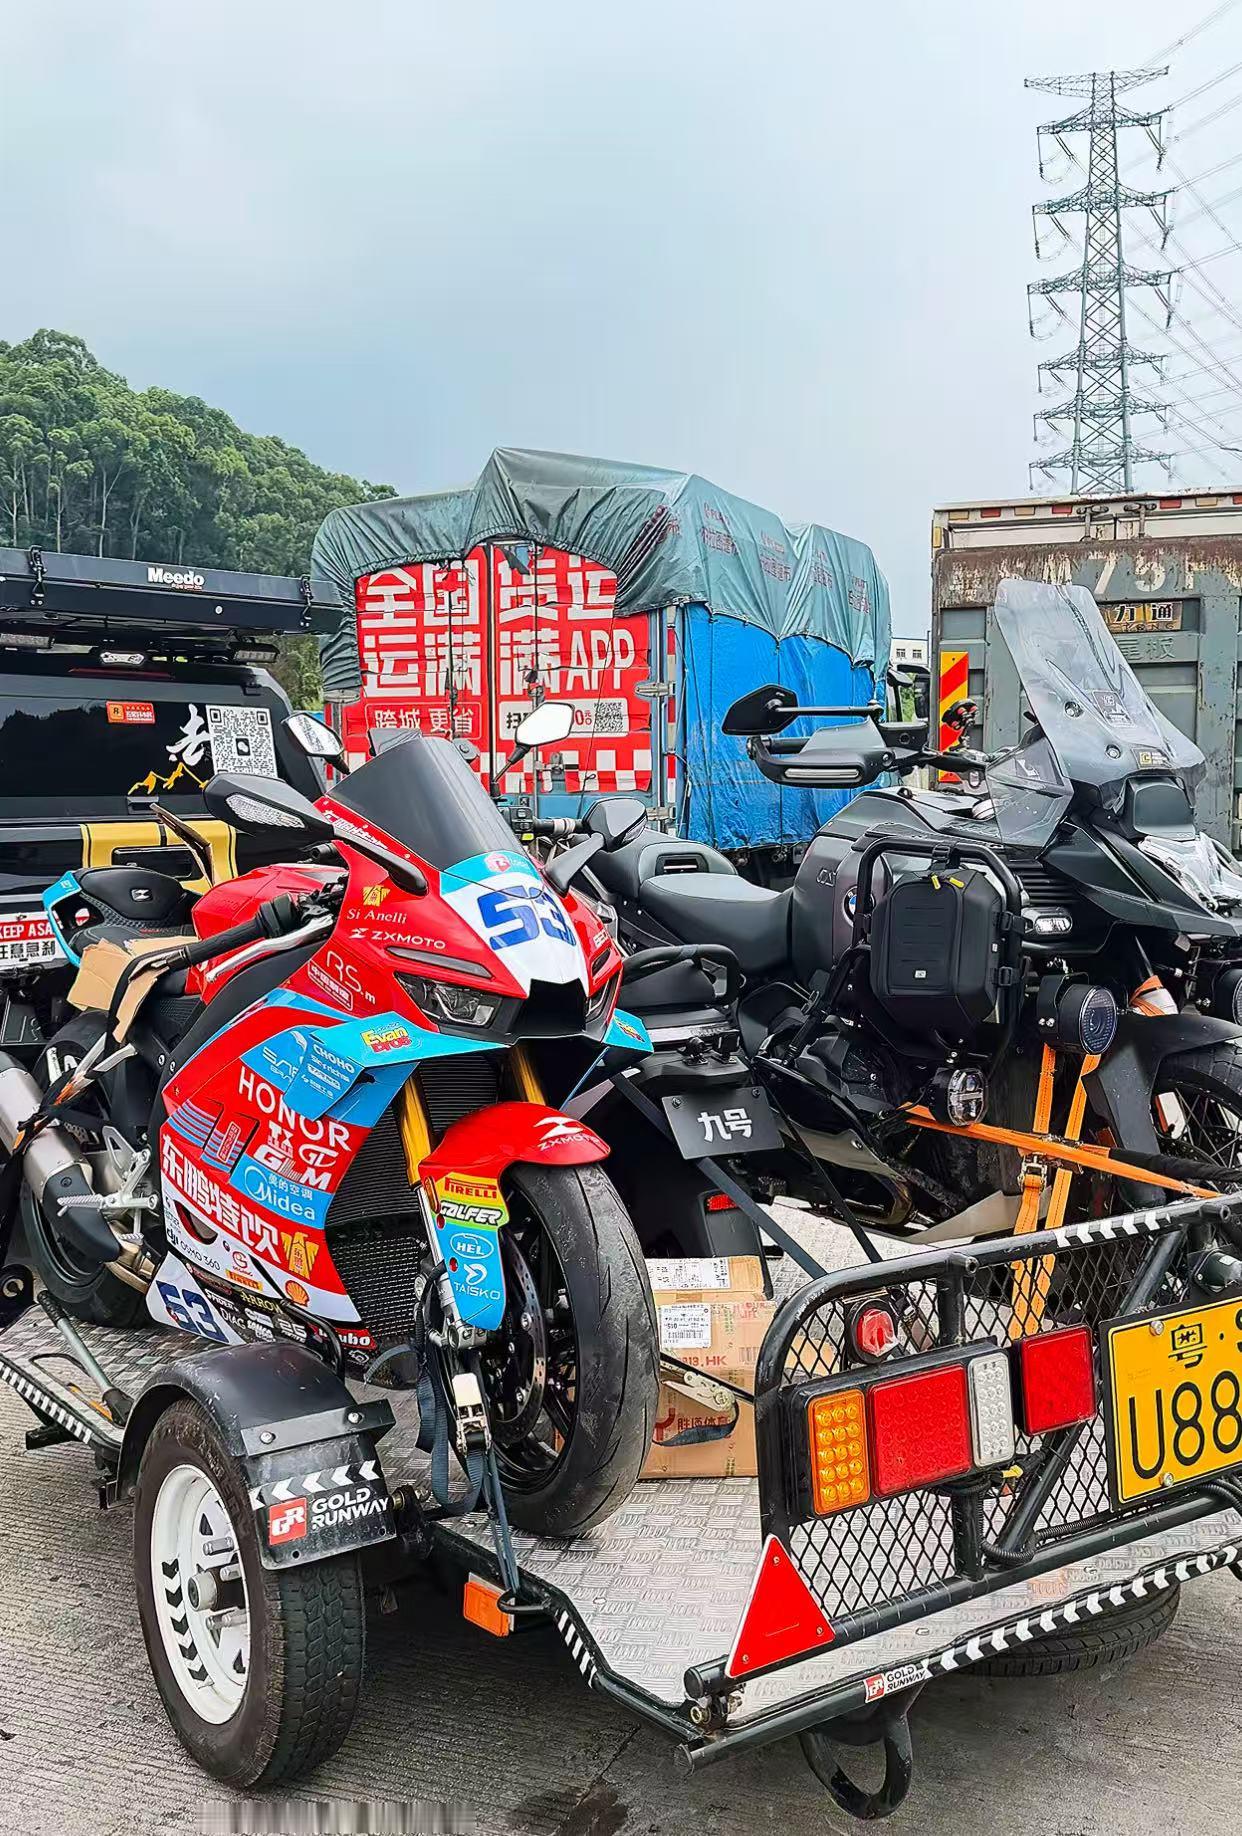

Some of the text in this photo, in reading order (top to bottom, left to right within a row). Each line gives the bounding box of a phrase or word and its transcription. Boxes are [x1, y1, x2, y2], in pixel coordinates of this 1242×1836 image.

[147, 567, 205, 585] Meedo
[347, 908, 407, 925] Si Anelli
[477, 885, 577, 951] 53
[371, 930, 446, 950] ZXMOTO
[313, 1043, 355, 1074] CHOHO
[238, 1066, 352, 1152] HONOR
[697, 1107, 752, 1142] 九号
[538, 1132, 600, 1151] ZXMOTO
[247, 1170, 315, 1220] Midea
[444, 1177, 498, 1199] PIRELLI
[439, 1201, 503, 1226] GALFER
[456, 1242, 486, 1256] HEL
[454, 1281, 501, 1300] TAISKO
[155, 1279, 230, 1344] 53
[311, 1487, 371, 1515] GOLD
[311, 1497, 389, 1530] RUNWAY
[886, 1666, 915, 1683] GOLD
[887, 1669, 926, 1692] RUNWAY
